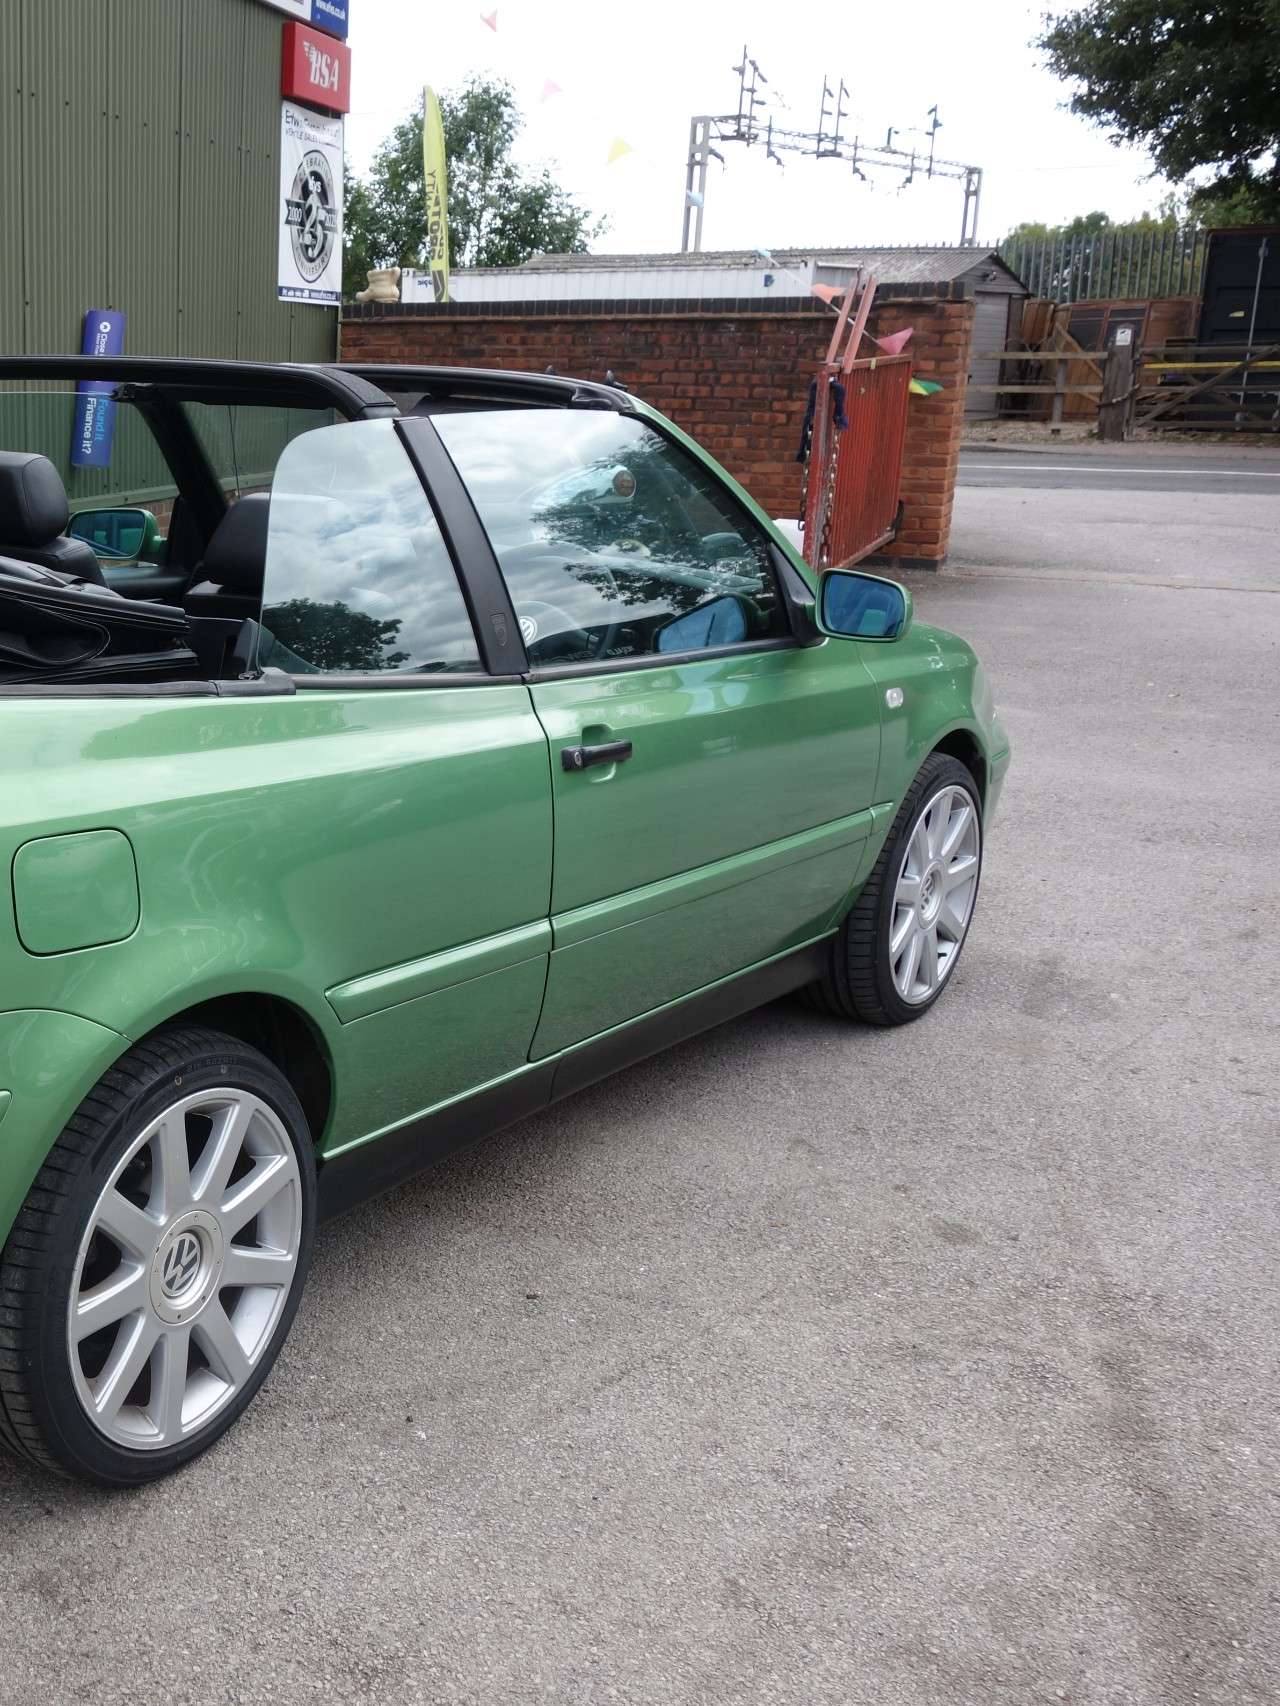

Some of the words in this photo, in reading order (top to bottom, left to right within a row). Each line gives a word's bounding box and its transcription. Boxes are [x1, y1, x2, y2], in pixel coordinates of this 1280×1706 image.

[309, 48, 340, 92] BSA
[84, 398, 97, 438] Finance
[82, 440, 92, 454] it?
